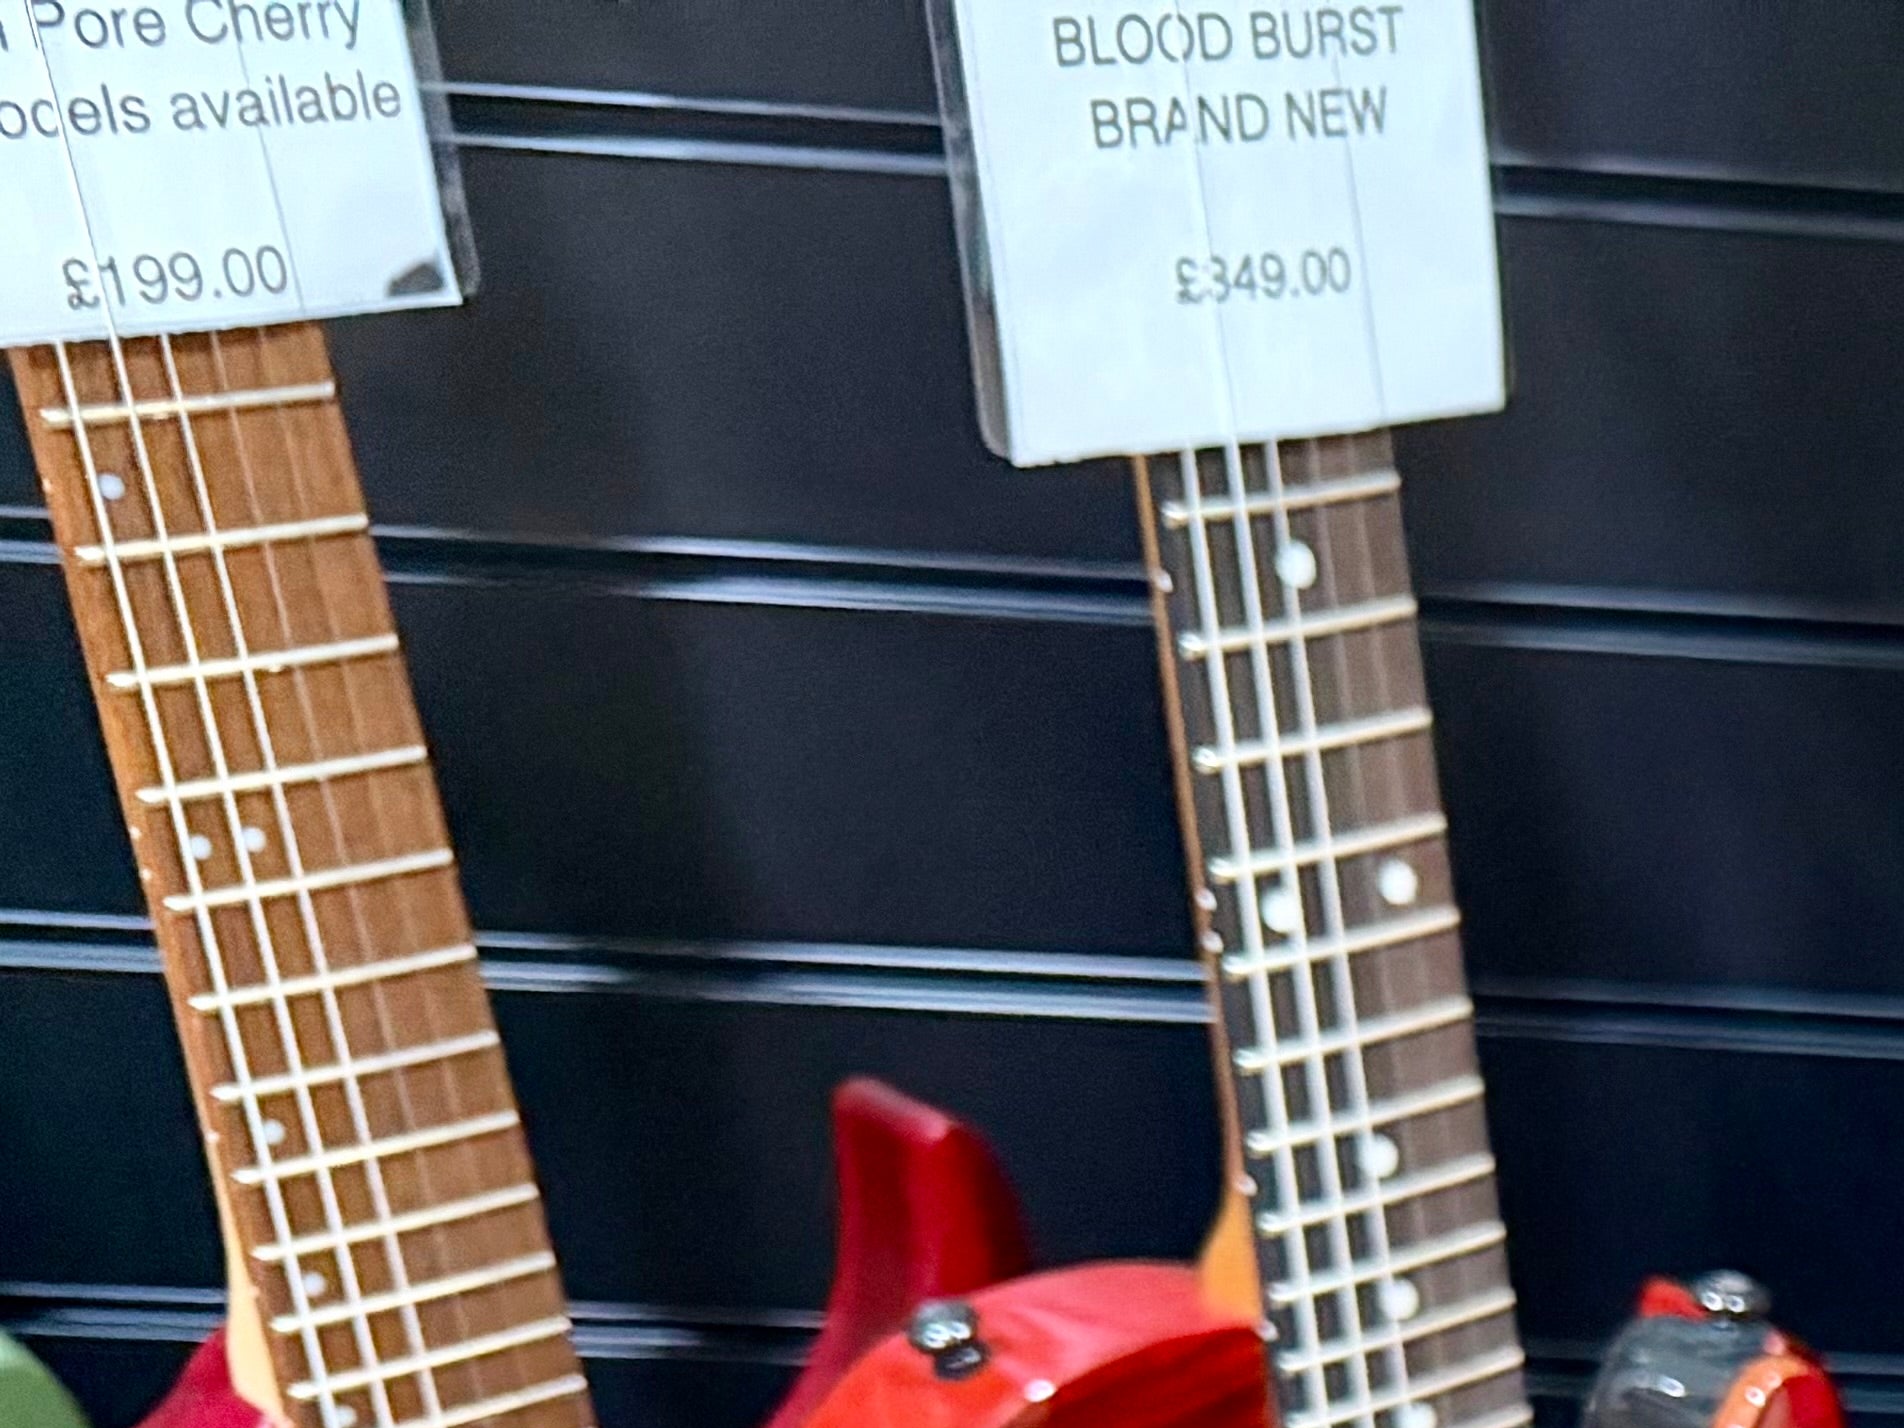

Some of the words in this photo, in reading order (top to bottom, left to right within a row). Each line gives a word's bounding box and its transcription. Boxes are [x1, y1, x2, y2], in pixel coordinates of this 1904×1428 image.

[31, 0, 166, 48] Pore
[187, 0, 360, 49] Cherry
[1053, 12, 1233, 67] BLOOD
[1251, 6, 1404, 60] BURST
[170, 70, 402, 131] available
[1090, 93, 1270, 148] BRAND
[1286, 86, 1388, 138] NEW
[62, 245, 288, 311] £199.00
[1176, 247, 1352, 304] £349.00
